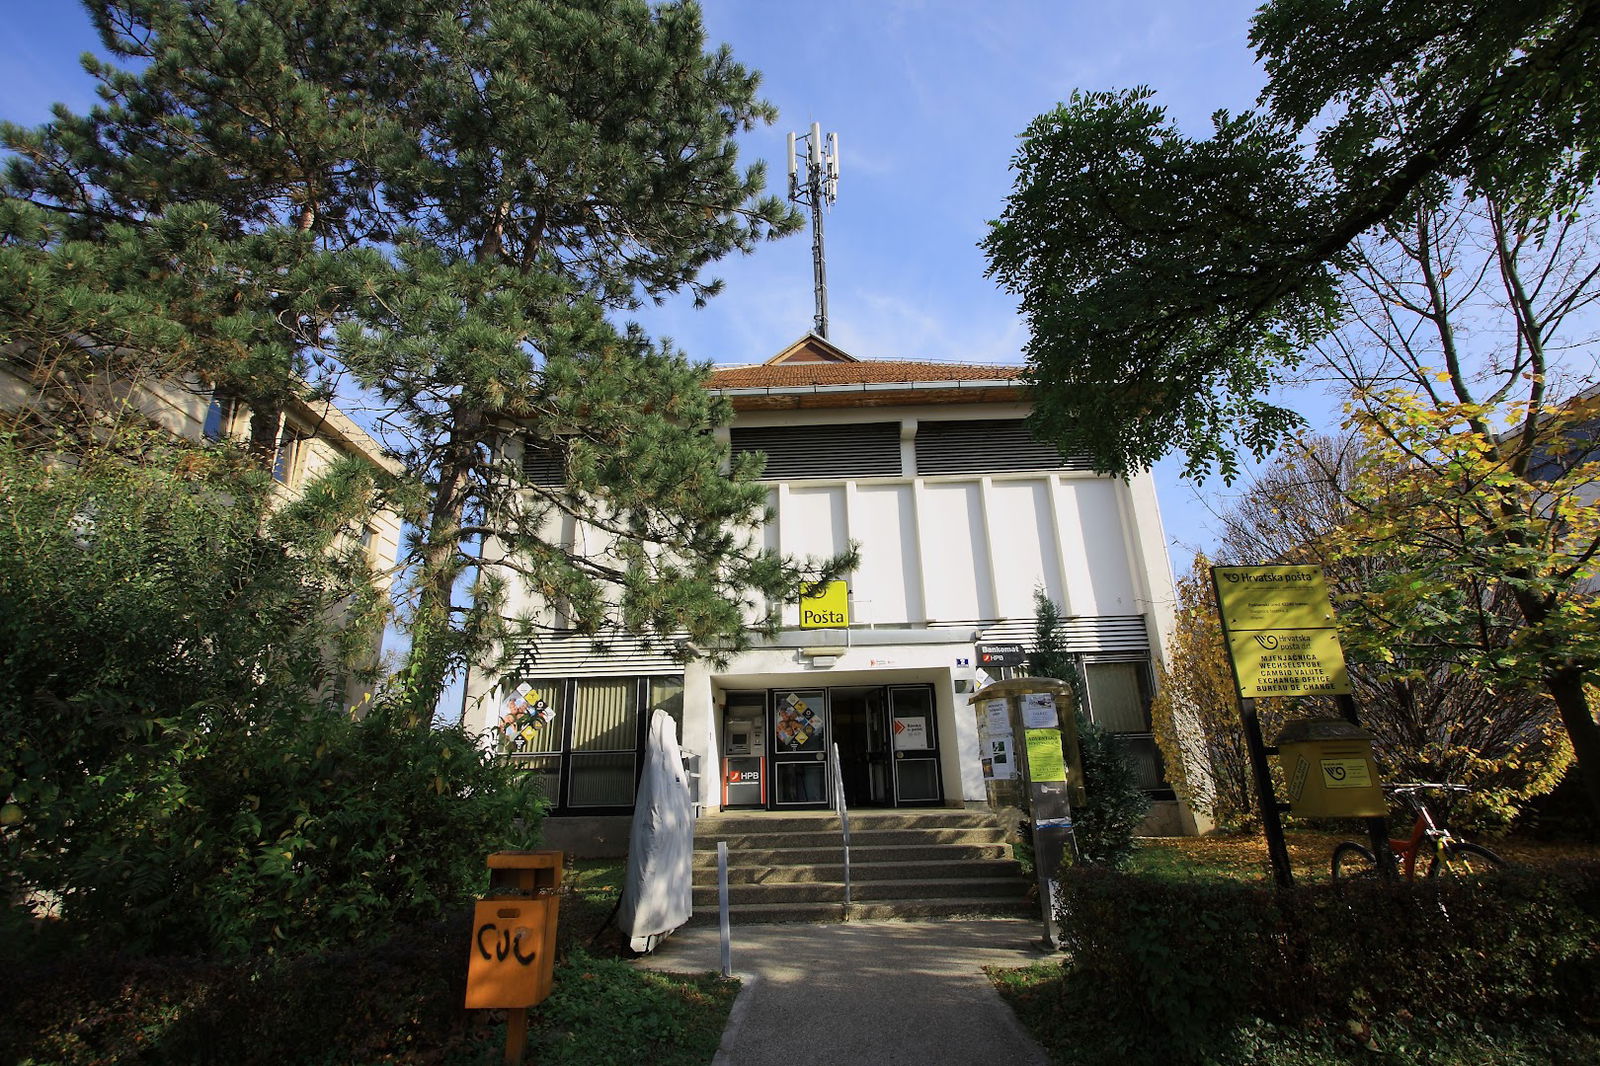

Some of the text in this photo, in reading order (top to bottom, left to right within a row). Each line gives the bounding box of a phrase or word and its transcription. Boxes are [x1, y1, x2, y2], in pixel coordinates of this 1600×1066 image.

[1240, 572, 1312, 583] Hrvatska pošta
[804, 609, 844, 624] Pošta
[1278, 634, 1311, 642] Hrvatska
[982, 645, 1019, 653] Bankomat
[1259, 661, 1322, 669] WECHSELSTUBE
[1260, 668, 1324, 677] CAMBIO VALUTE
[1257, 675, 1330, 684] EXCHANGE OFFICE
[1256, 684, 1288, 692] BUREAU
[1303, 683, 1336, 691] CHANGE
[740, 771, 759, 780] HPB
